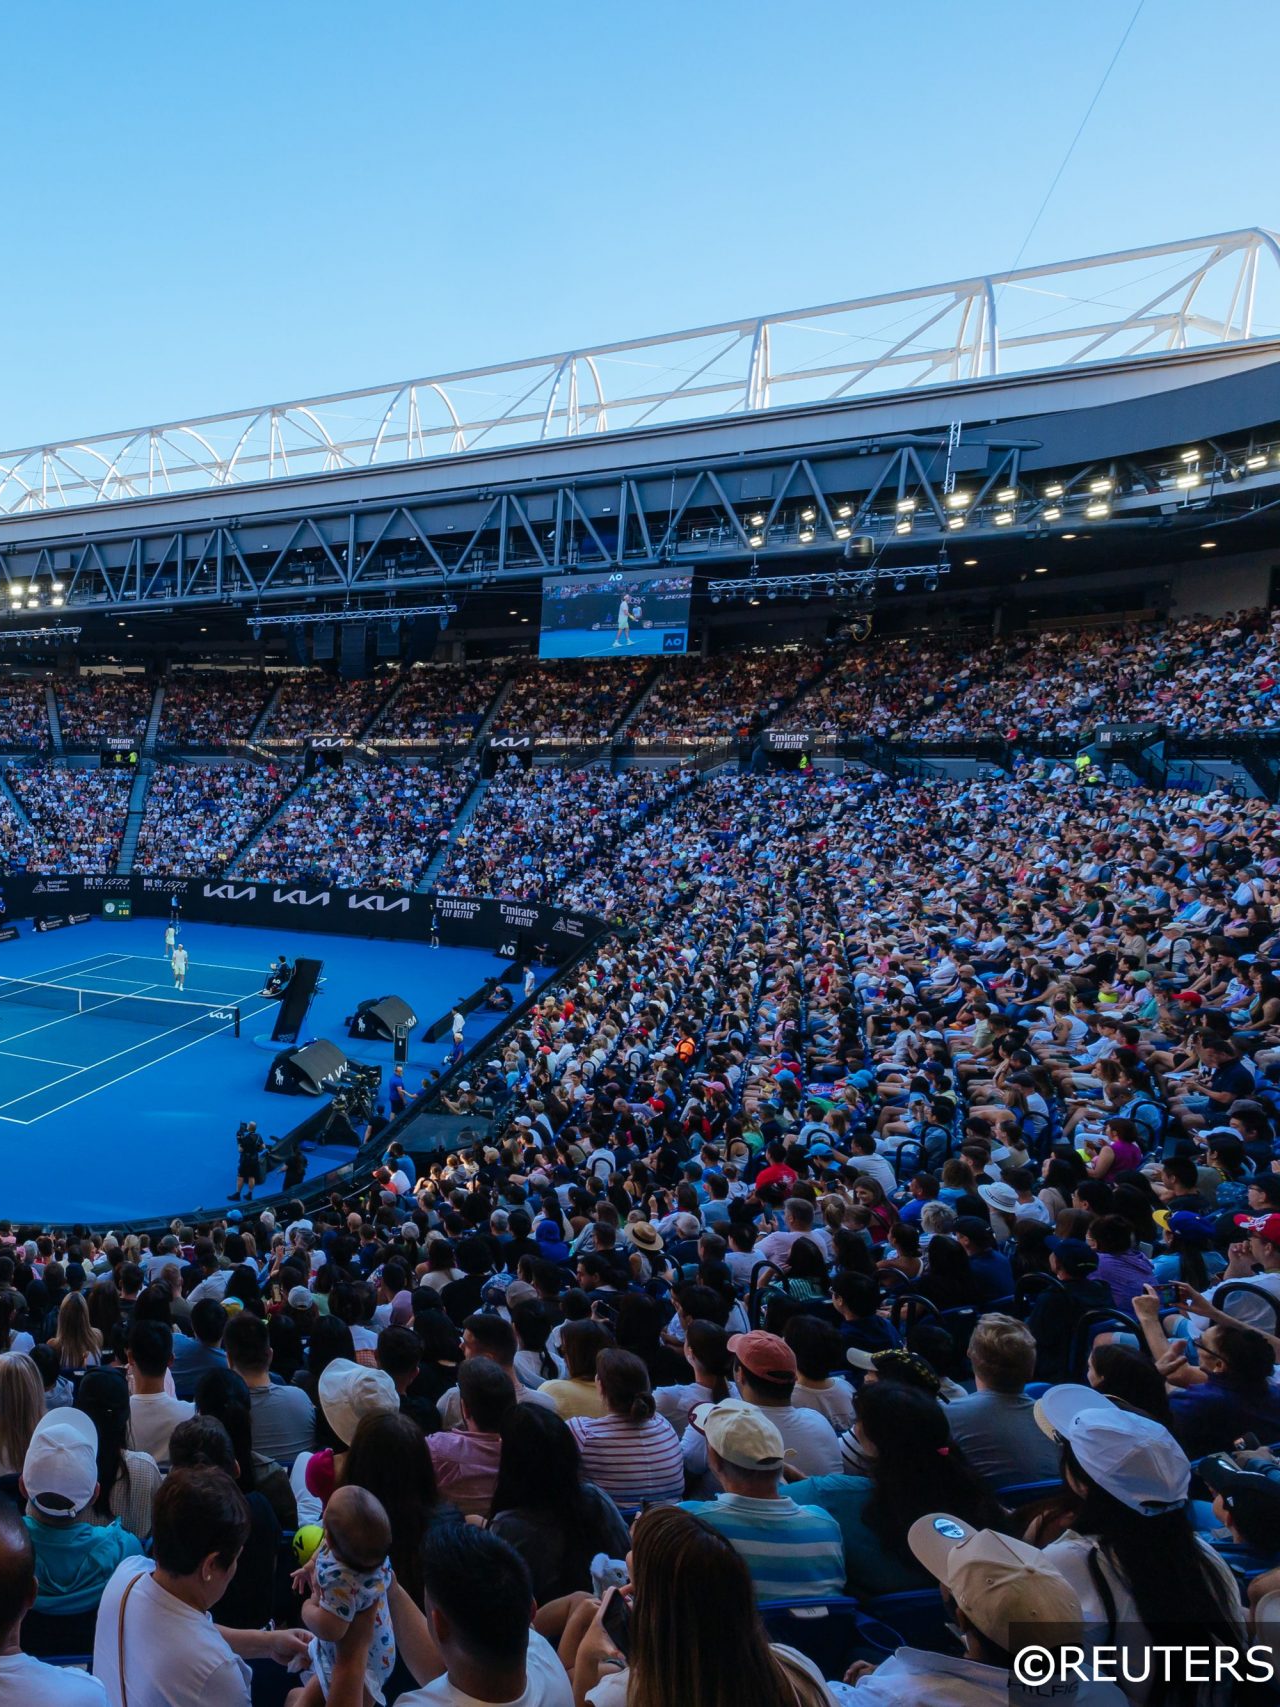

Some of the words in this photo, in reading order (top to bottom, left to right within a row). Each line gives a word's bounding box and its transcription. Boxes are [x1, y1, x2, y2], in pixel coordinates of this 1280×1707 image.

[608, 573, 623, 581] AO
[665, 638, 682, 646] AO
[770, 733, 810, 742] Emirates
[203, 884, 256, 900] KIA
[273, 889, 330, 906] KIA
[349, 894, 410, 912] KIA
[436, 899, 481, 911] Emirates
[442, 909, 453, 917] FLY
[453, 910, 474, 919] BETTER
[500, 904, 539, 919] Emirates
[505, 916, 514, 924] FLY
[515, 917, 533, 927] BETTER
[500, 944, 516, 956] AO
